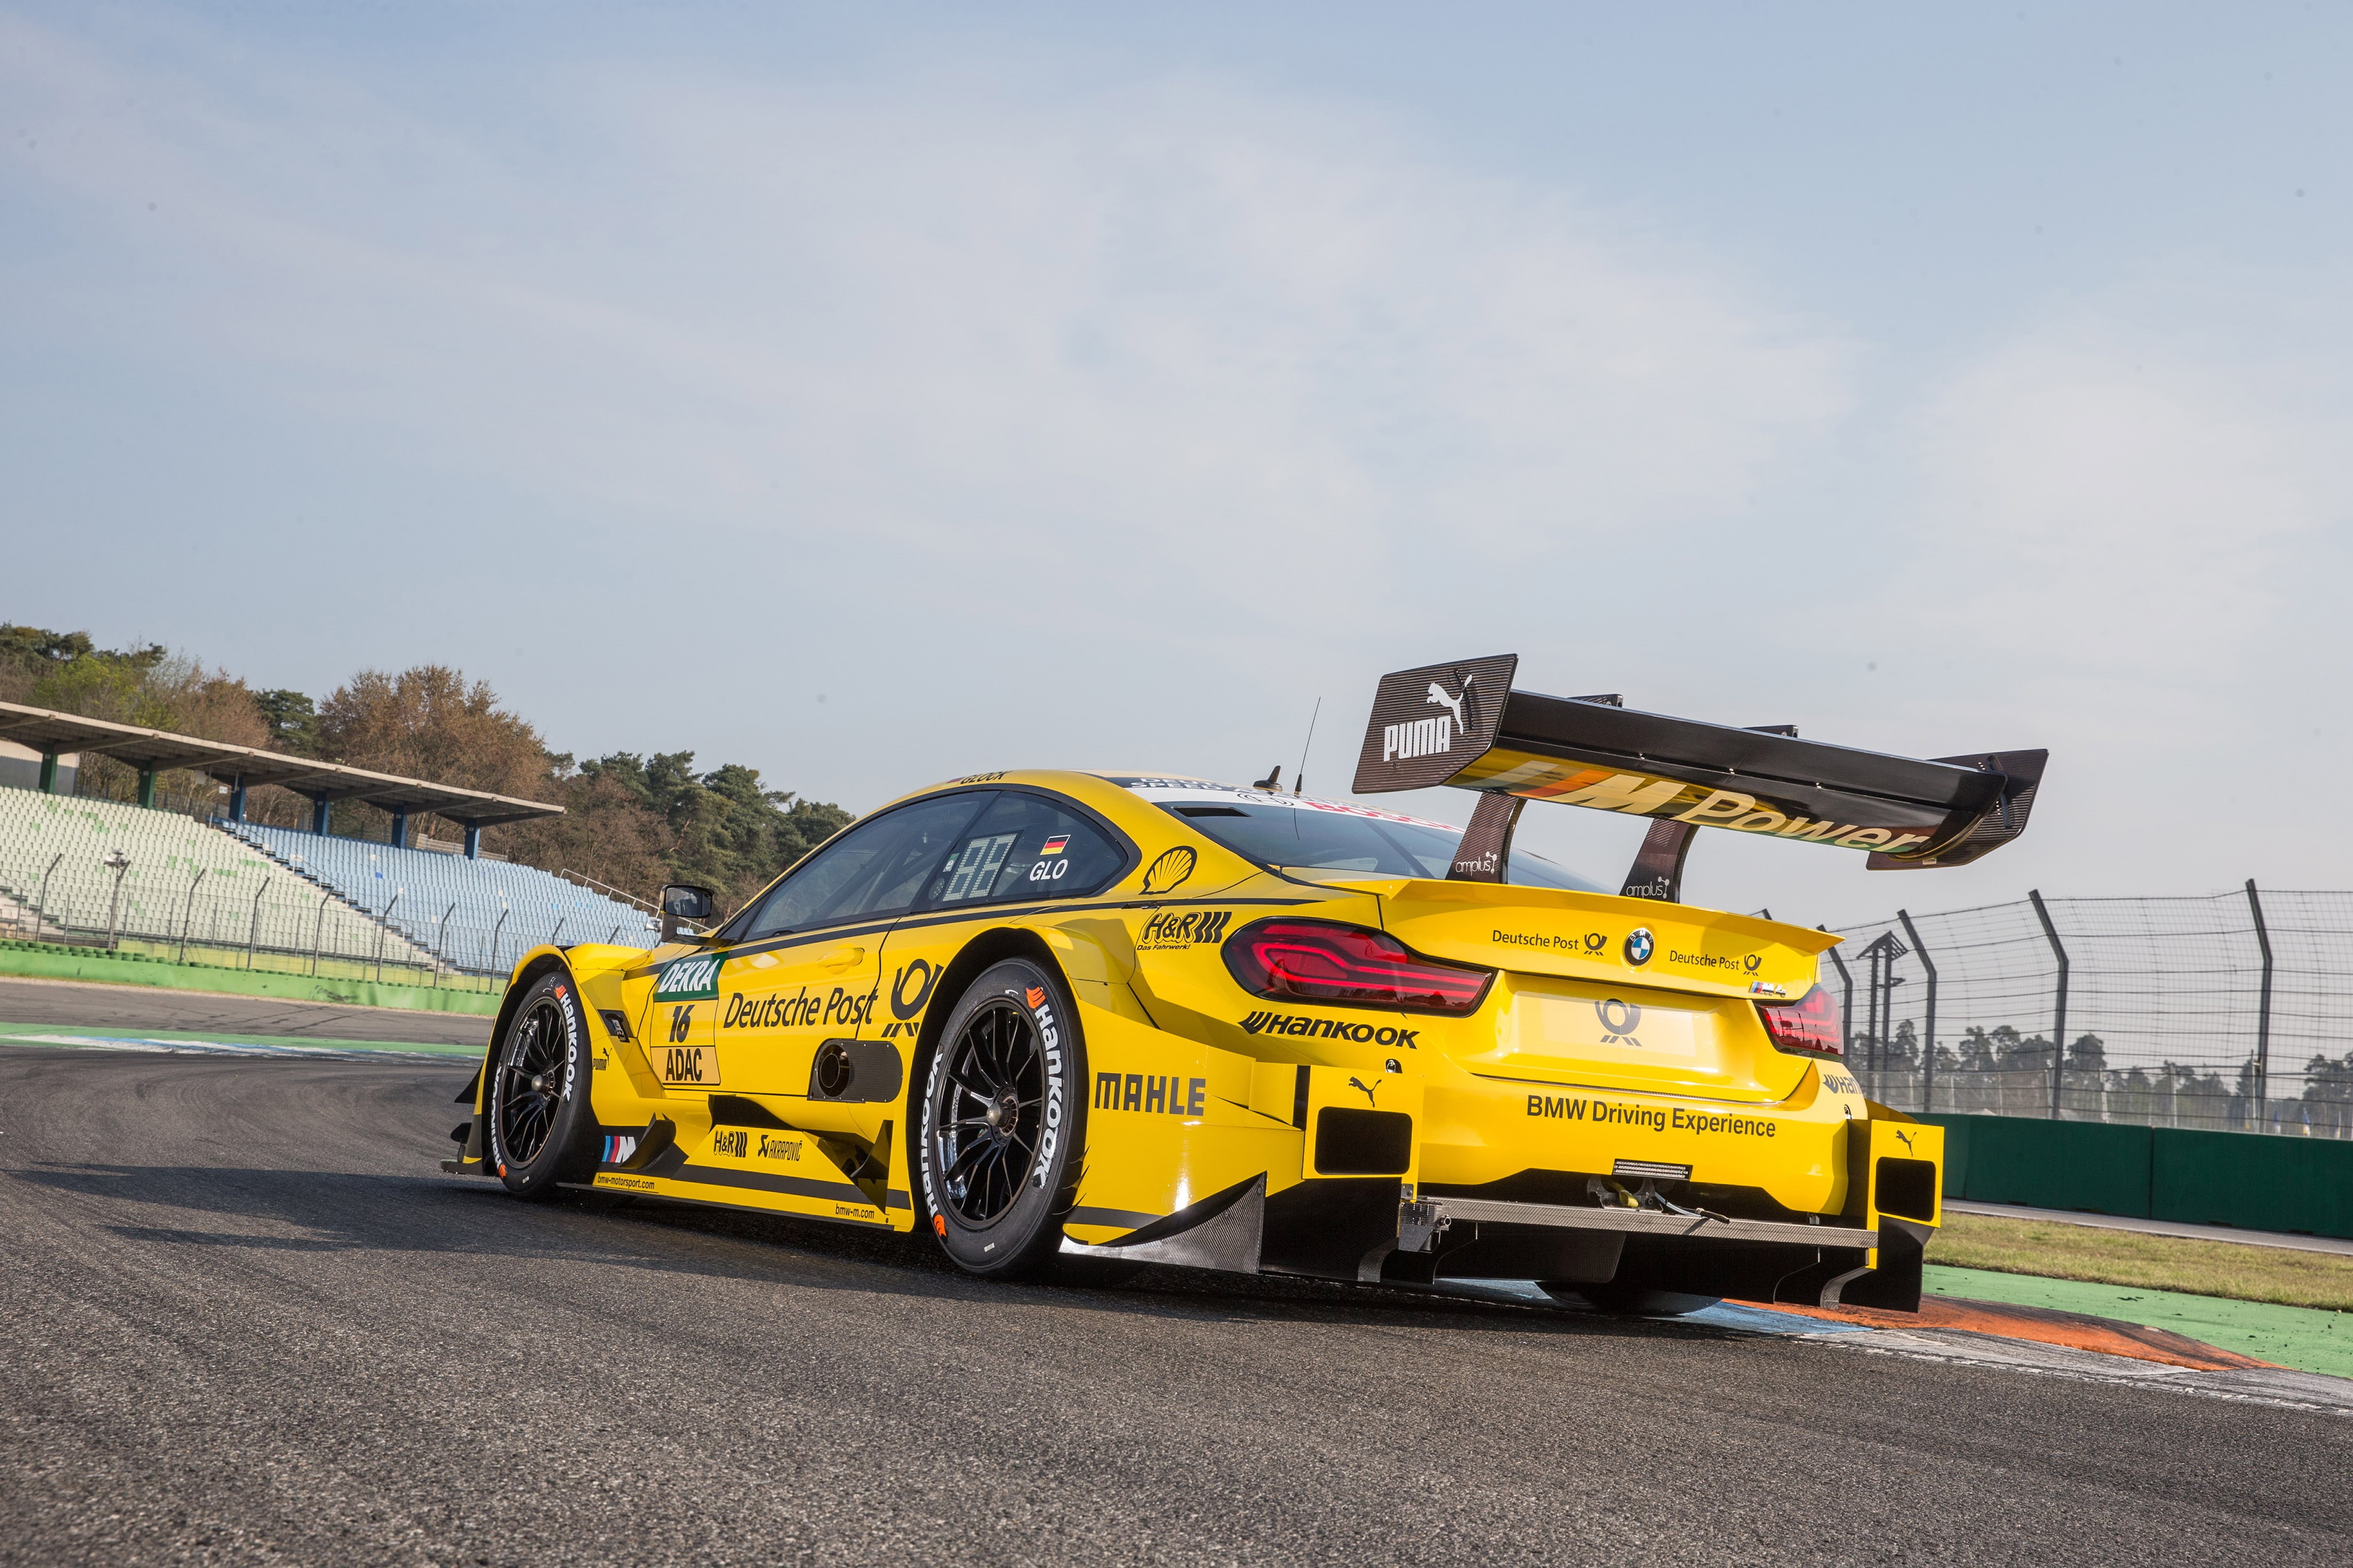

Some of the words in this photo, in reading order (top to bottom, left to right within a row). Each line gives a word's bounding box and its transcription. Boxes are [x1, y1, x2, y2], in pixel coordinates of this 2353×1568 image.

[1383, 716, 1451, 762] PUMA
[960, 770, 1013, 785] GLOCK
[1131, 782, 1222, 790] SPEED
[1538, 774, 1687, 815] M
[1669, 790, 1931, 852] Power
[1029, 859, 1069, 882] GLO
[1455, 858, 1491, 874] amplus
[1626, 882, 1662, 899] amplus
[1142, 912, 1202, 944] H&R
[1492, 930, 1550, 948] Deutsche
[1553, 935, 1579, 951] Post
[1669, 951, 1716, 968] Deutsche
[1719, 956, 1739, 971] Post
[658, 959, 720, 992] DEKRA
[723, 986, 820, 1029] Deutsche
[823, 987, 879, 1025] Post
[670, 1005, 695, 1043] 16
[592, 1058, 607, 1071] PUMA
[665, 1046, 703, 1082] ADAC
[1094, 1072, 1206, 1116] MAHLE
[1527, 1095, 1587, 1121] BMW
[1592, 1100, 1666, 1132] Driving
[1672, 1107, 1776, 1138] Experience
[597, 1173, 655, 1190] bmw-motorsport.com
[835, 1203, 875, 1220] bmw-m.com
